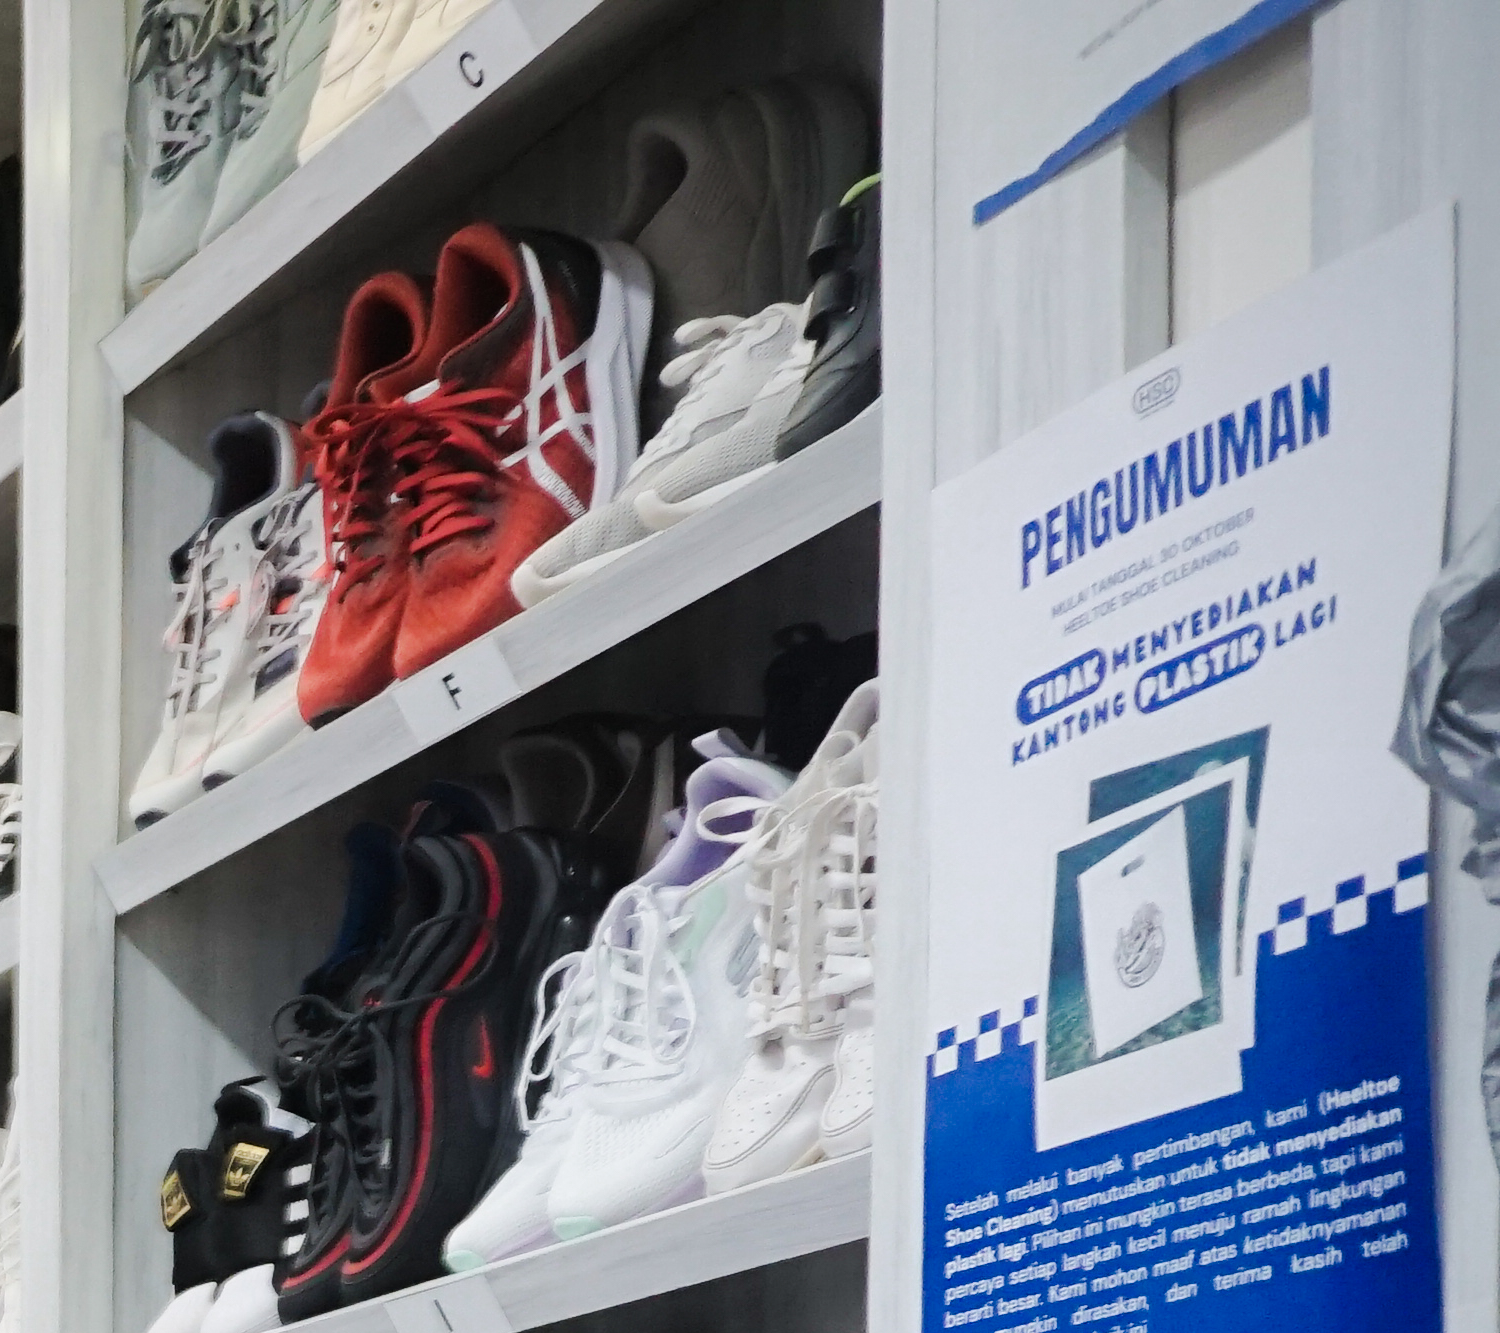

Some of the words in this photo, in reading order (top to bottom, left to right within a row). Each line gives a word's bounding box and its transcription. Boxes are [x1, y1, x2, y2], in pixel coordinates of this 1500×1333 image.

[459, 51, 484, 88] C
[1020, 363, 1331, 590] PENGUMUMAN
[1090, 555, 1156, 597] TANGGAL
[1182, 507, 1255, 552] OKTOBER
[1121, 578, 1160, 608] SHOE
[1161, 540, 1240, 588] CLEANING
[442, 672, 462, 710] F
[1011, 691, 1126, 767] KANTONG
[1136, 629, 1260, 710] PLASTIK
[1274, 594, 1337, 649] LAGI
[1026, 654, 1101, 716] TIDAK
[1112, 556, 1317, 674] MENYEDIAKAN
[944, 1225, 983, 1247] Shoe
[984, 1199, 1059, 1238] Cleaning)
[1061, 1176, 1166, 1215] memutuskan
[1168, 1156, 1219, 1186] untuk
[1221, 1141, 1271, 1170] tidak
[1274, 1108, 1402, 1157] menyediakan
[944, 1246, 996, 1279] plastik
[1031, 1227, 1081, 1251] Pilihan
[1083, 1216, 1104, 1237] ini
[1106, 1199, 1175, 1232] mungkin
[1178, 1186, 1233, 1212] terasa
[1321, 1147, 1356, 1175] tapi
[1359, 1133, 1403, 1164] kami
[945, 1191, 998, 1222] Setelah
[1005, 1171, 1059, 1203] melalui
[1066, 1154, 1124, 1186] banyak
[1265, 1099, 1307, 1128] kami
[1318, 1075, 1400, 1115] (Heeltoe
[944, 1275, 1005, 1305] percaya
[1008, 1262, 1057, 1286] setiap
[1061, 1242, 1122, 1271] langkah
[1126, 1227, 1167, 1255] kecil
[1171, 1212, 1236, 1243] menuju
[1241, 1194, 1301, 1225] ramah
[1308, 1170, 1406, 1209] lingkungan
[1048, 1277, 1088, 1303] Kami
[1091, 1267, 1148, 1292] mohon
[1152, 1249, 1195, 1277] maaf
[1199, 1244, 1238, 1266] atas
[1243, 1202, 1407, 1254] ketidaknyamanan
[1165, 1282, 1198, 1303] dan
[1213, 1265, 1272, 1291] terima
[1291, 1245, 1342, 1273] kasih
[1362, 1230, 1408, 1258] telah
